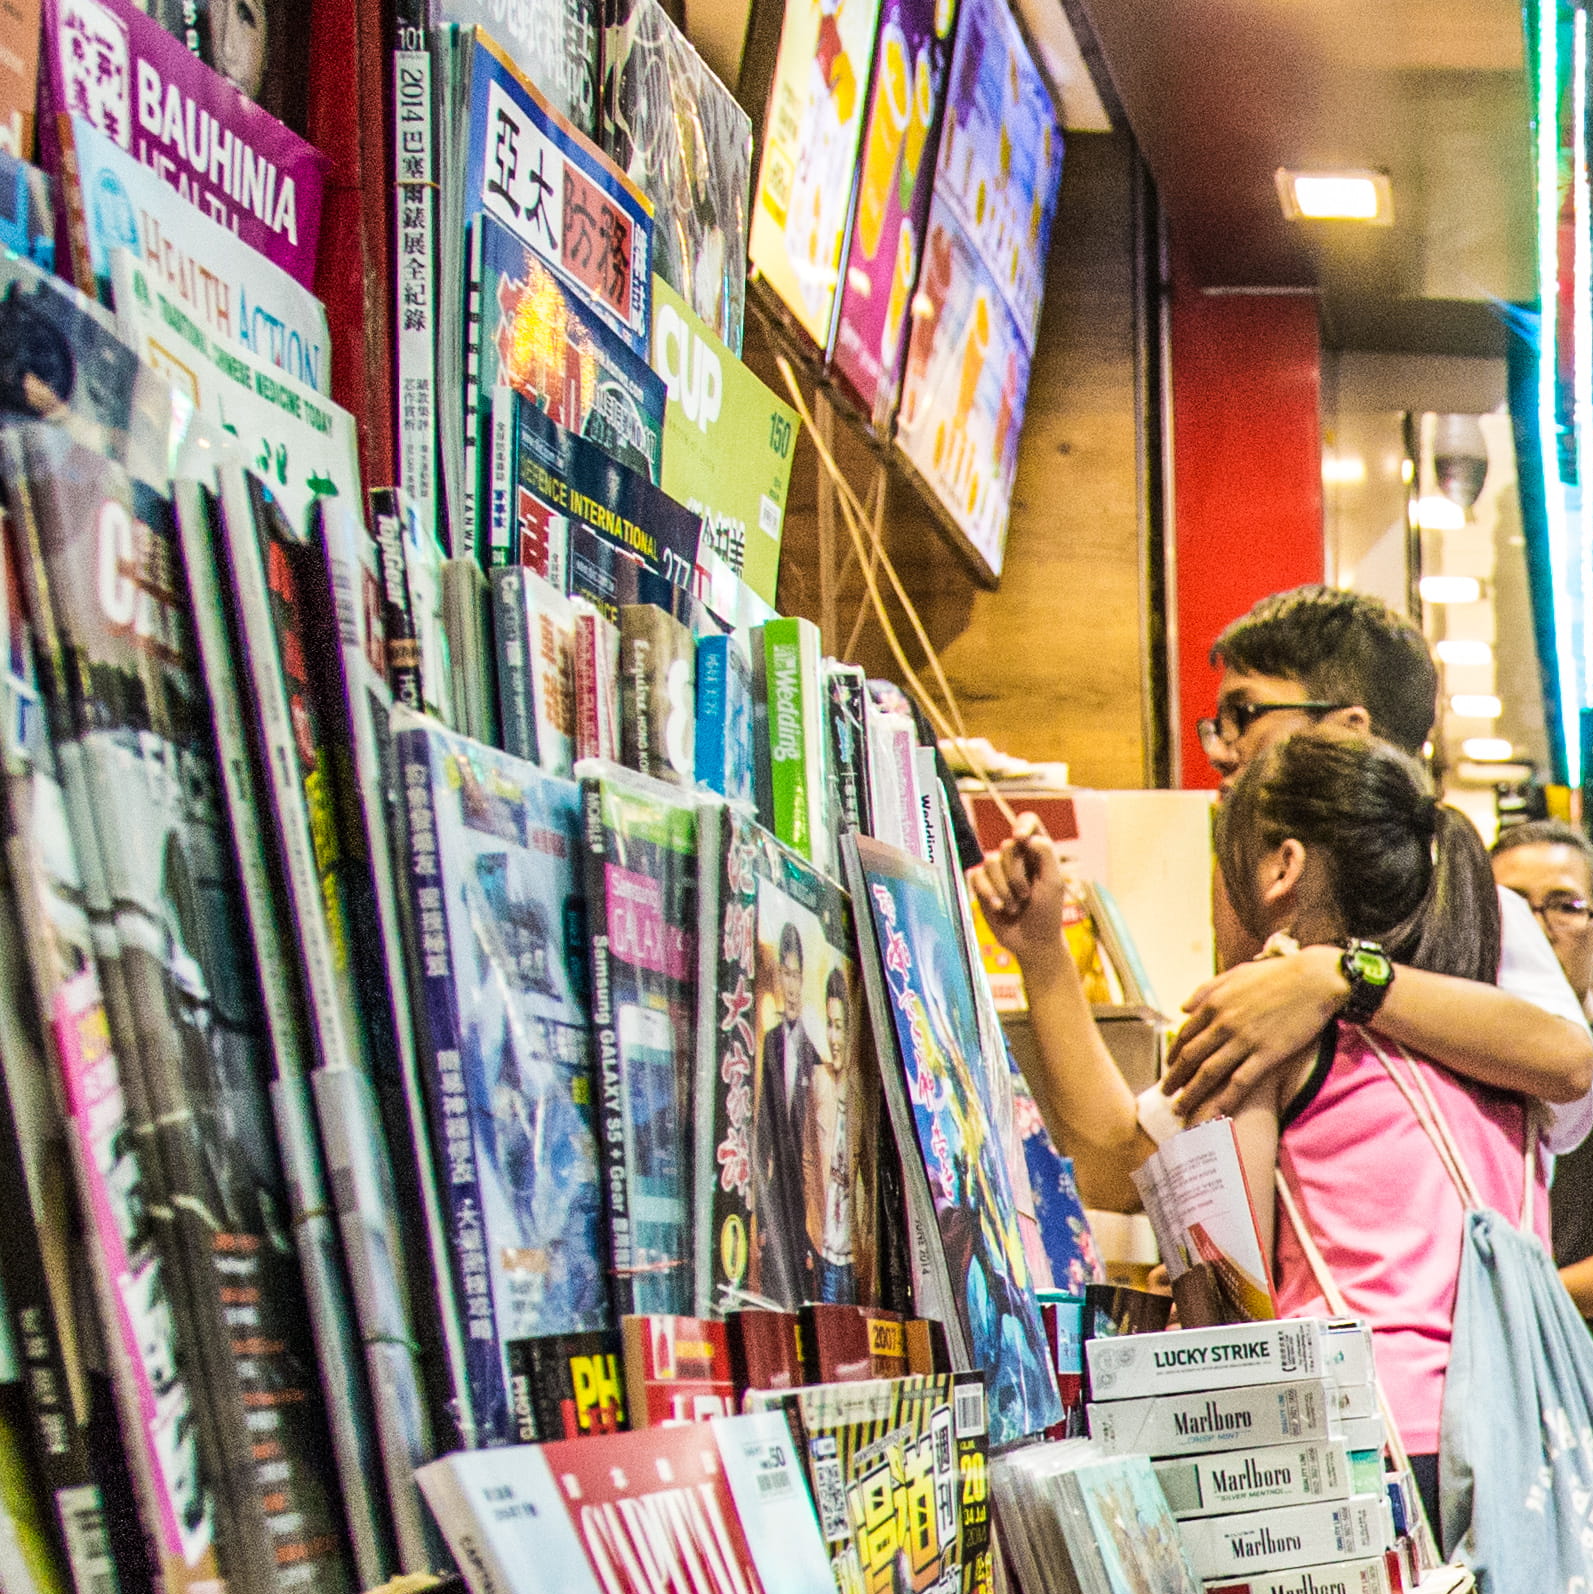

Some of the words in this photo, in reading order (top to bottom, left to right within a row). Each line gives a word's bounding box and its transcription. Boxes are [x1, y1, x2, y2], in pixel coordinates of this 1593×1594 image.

[137, 57, 298, 247] BAUHINIA
[656, 303, 723, 434] CUP
[769, 411, 791, 459] 150
[570, 488, 659, 562] INTERNATIONAL
[592, 935, 611, 1024] Samsung
[599, 1029, 623, 1112] GALAXY
[1153, 1346, 1209, 1369] LUCKY
[1211, 1340, 1271, 1363] STRIKE
[1173, 1400, 1253, 1437] Marlboro
[1212, 1457, 1293, 1495] Marlboro
[1230, 1526, 1303, 1560] Marlboro
